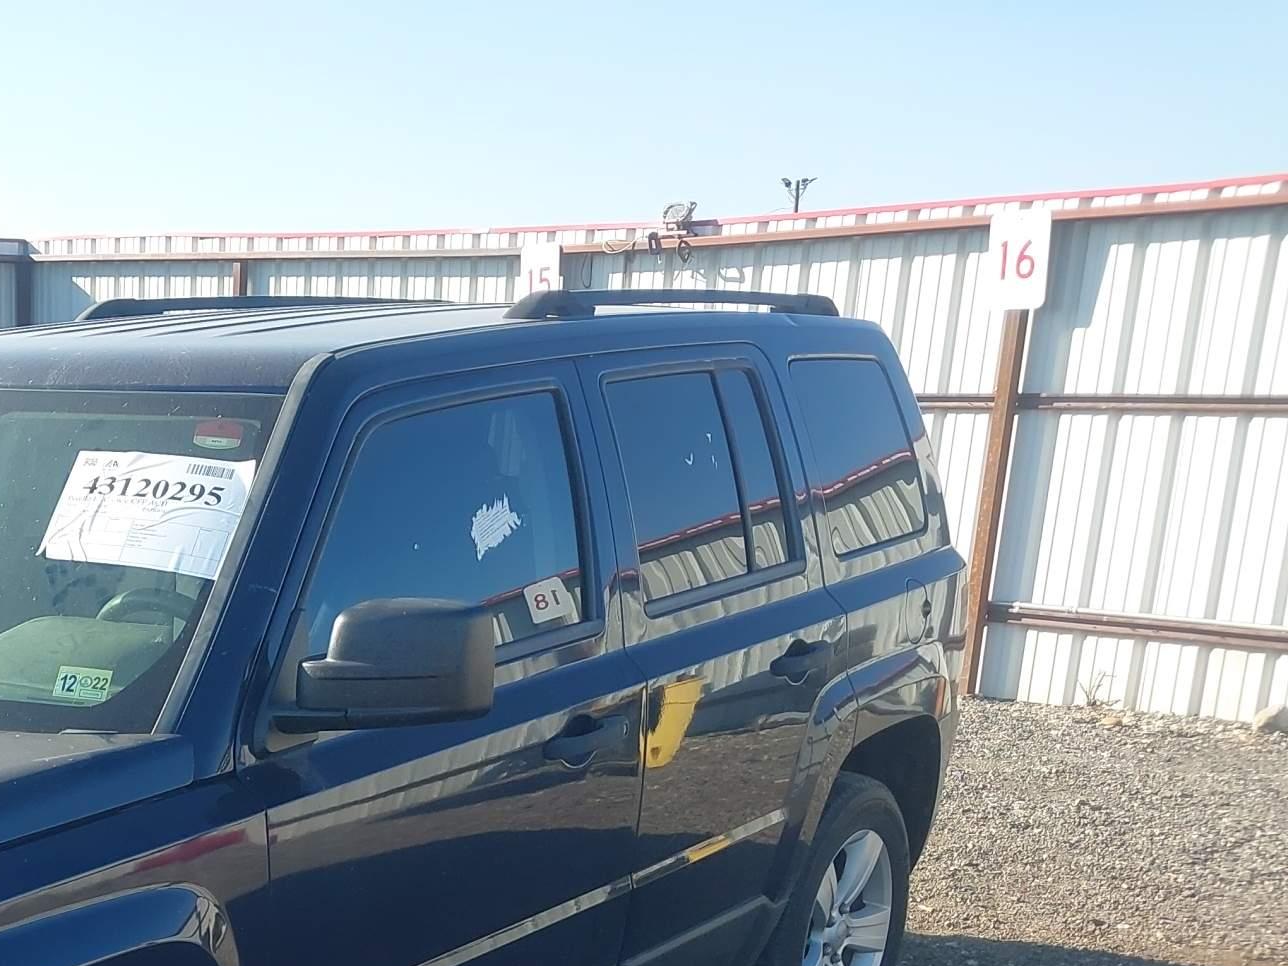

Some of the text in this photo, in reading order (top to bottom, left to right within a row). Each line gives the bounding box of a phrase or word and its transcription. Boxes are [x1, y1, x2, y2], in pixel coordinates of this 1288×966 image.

[1000, 239, 1035, 281] 16
[82, 474, 226, 507] 43120295
[60, 674, 109, 693] 12 22
